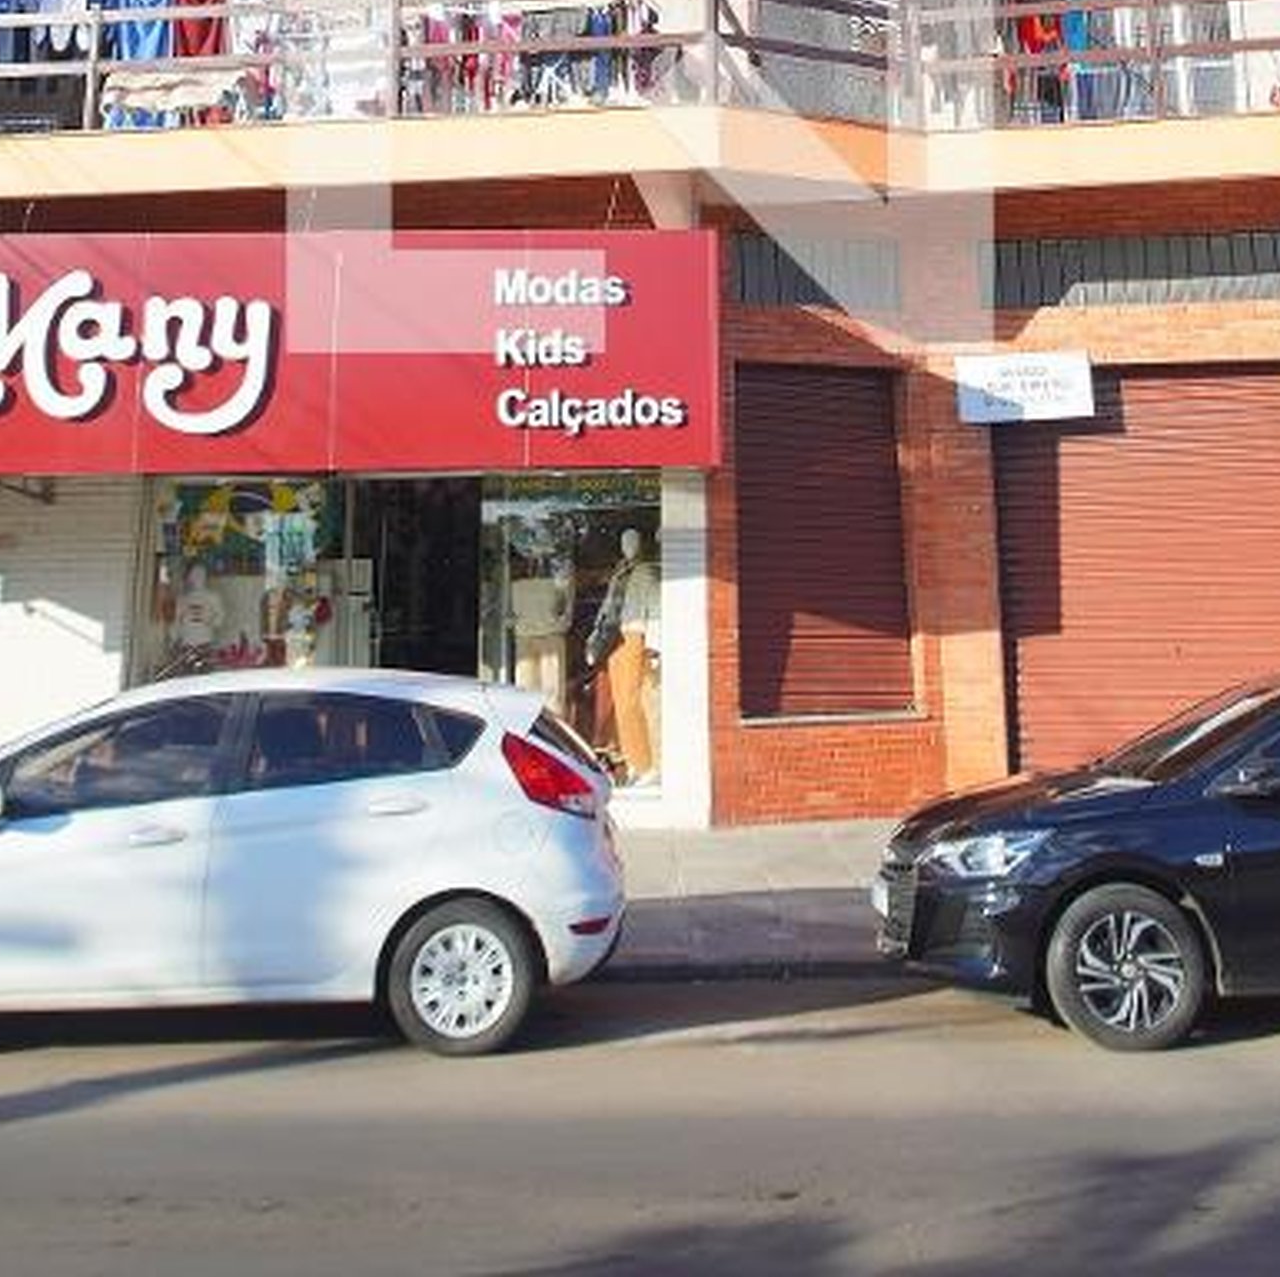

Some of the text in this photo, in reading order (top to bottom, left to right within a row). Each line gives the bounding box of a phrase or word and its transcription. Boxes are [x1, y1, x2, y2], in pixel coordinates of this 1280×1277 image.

[494, 269, 630, 306] Modas
[495, 328, 590, 367] Kids
[496, 388, 688, 436] Calçados
